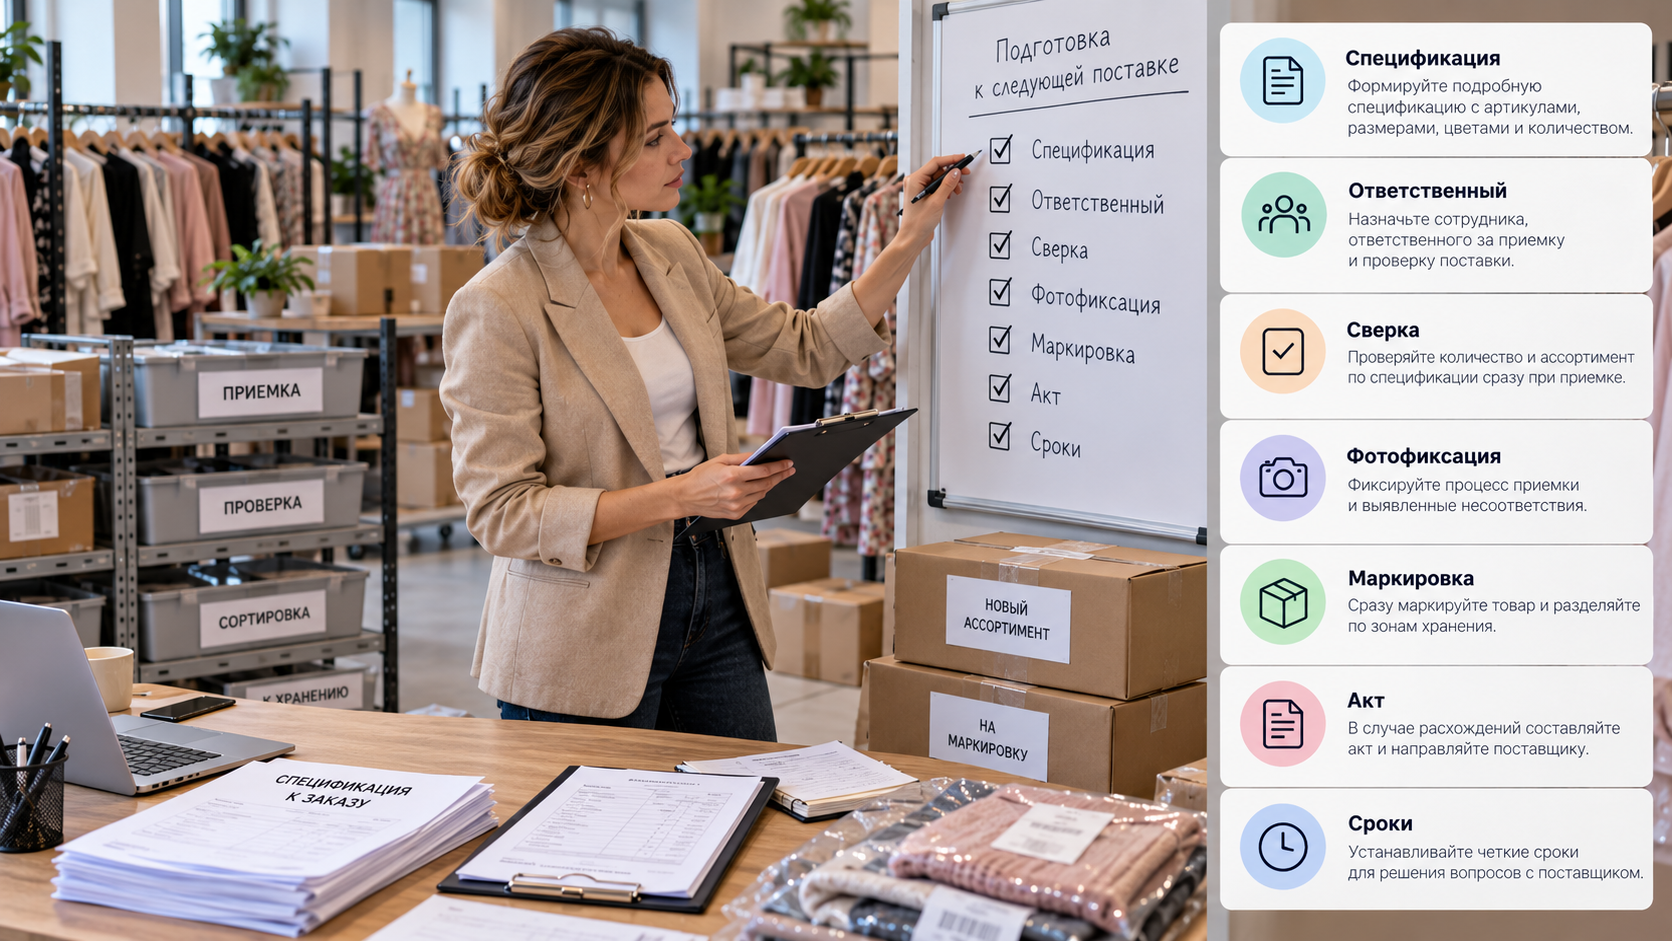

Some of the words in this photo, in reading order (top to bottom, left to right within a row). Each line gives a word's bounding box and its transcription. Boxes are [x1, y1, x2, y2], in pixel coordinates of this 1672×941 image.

[996, 29, 1111, 63] Подготовка
[975, 84, 984, 99] к
[992, 65, 1084, 98] следующей
[1092, 57, 1180, 84] поставке
[1032, 138, 1155, 165] Спецификация
[1031, 188, 1164, 215] Ответственный
[1031, 235, 1089, 264] Сверка
[1031, 282, 1161, 315] Фотофиксация
[1031, 332, 1136, 365] Маркировка
[223, 382, 302, 401] ПРИЕМКА
[1030, 381, 1062, 406] Акт
[1030, 430, 1081, 459] Сроки
[224, 495, 303, 515] ПРОВЕРКА
[218, 606, 311, 630] СОРТИРОВКА
[985, 598, 1028, 617] НОВЫЙ
[963, 616, 1050, 641] АССОРТИМЕНТ
[275, 685, 349, 704] ХРАНЕНИЮ
[979, 718, 996, 734] НА
[947, 733, 1028, 762] МАРКИРОВКУ
[275, 774, 413, 797] СПЕЦИФИКАЦИЯ
[285, 791, 301, 802] К
[301, 793, 371, 809] ЗАКАЗУ
